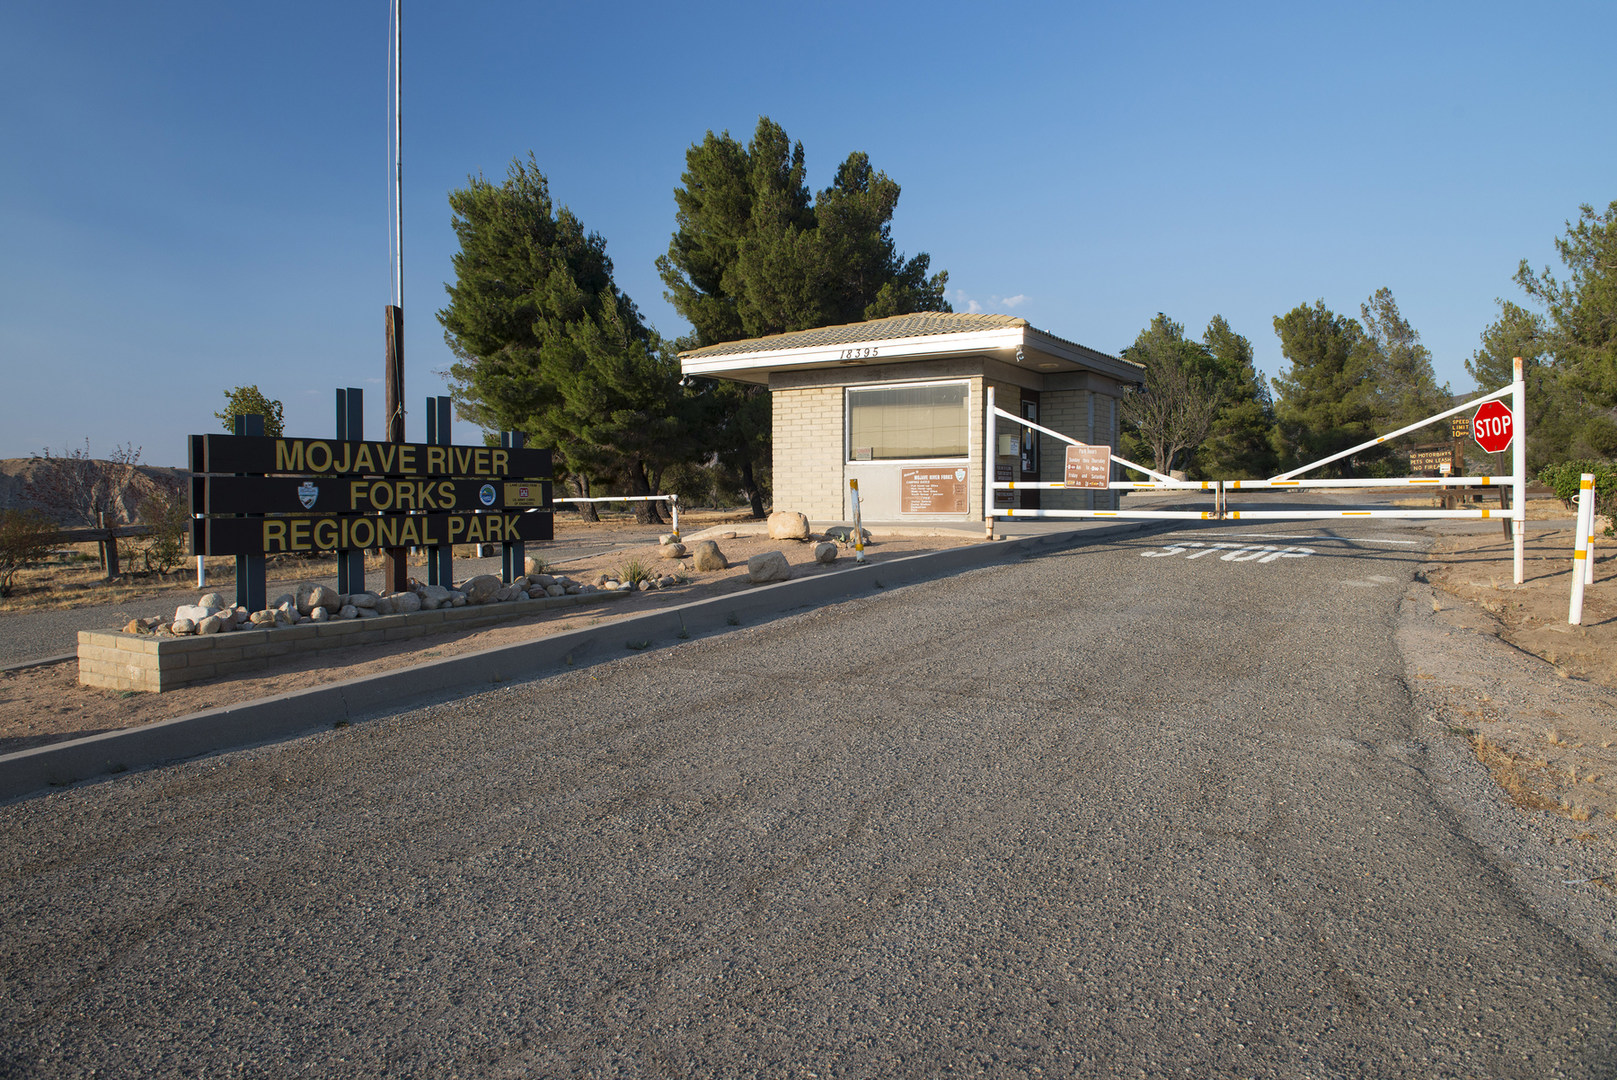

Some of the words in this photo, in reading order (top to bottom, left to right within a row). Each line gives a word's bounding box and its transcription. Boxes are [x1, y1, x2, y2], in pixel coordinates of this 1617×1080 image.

[840, 347, 879, 359] 18395
[1475, 415, 1511, 438] STOP
[276, 440, 417, 474] MOJAVE
[427, 446, 509, 475] RIVER
[350, 481, 456, 510] FORKS
[263, 517, 438, 551] REGIONAL
[448, 515, 521, 543] PARK
[1141, 542, 1316, 563] STOP
